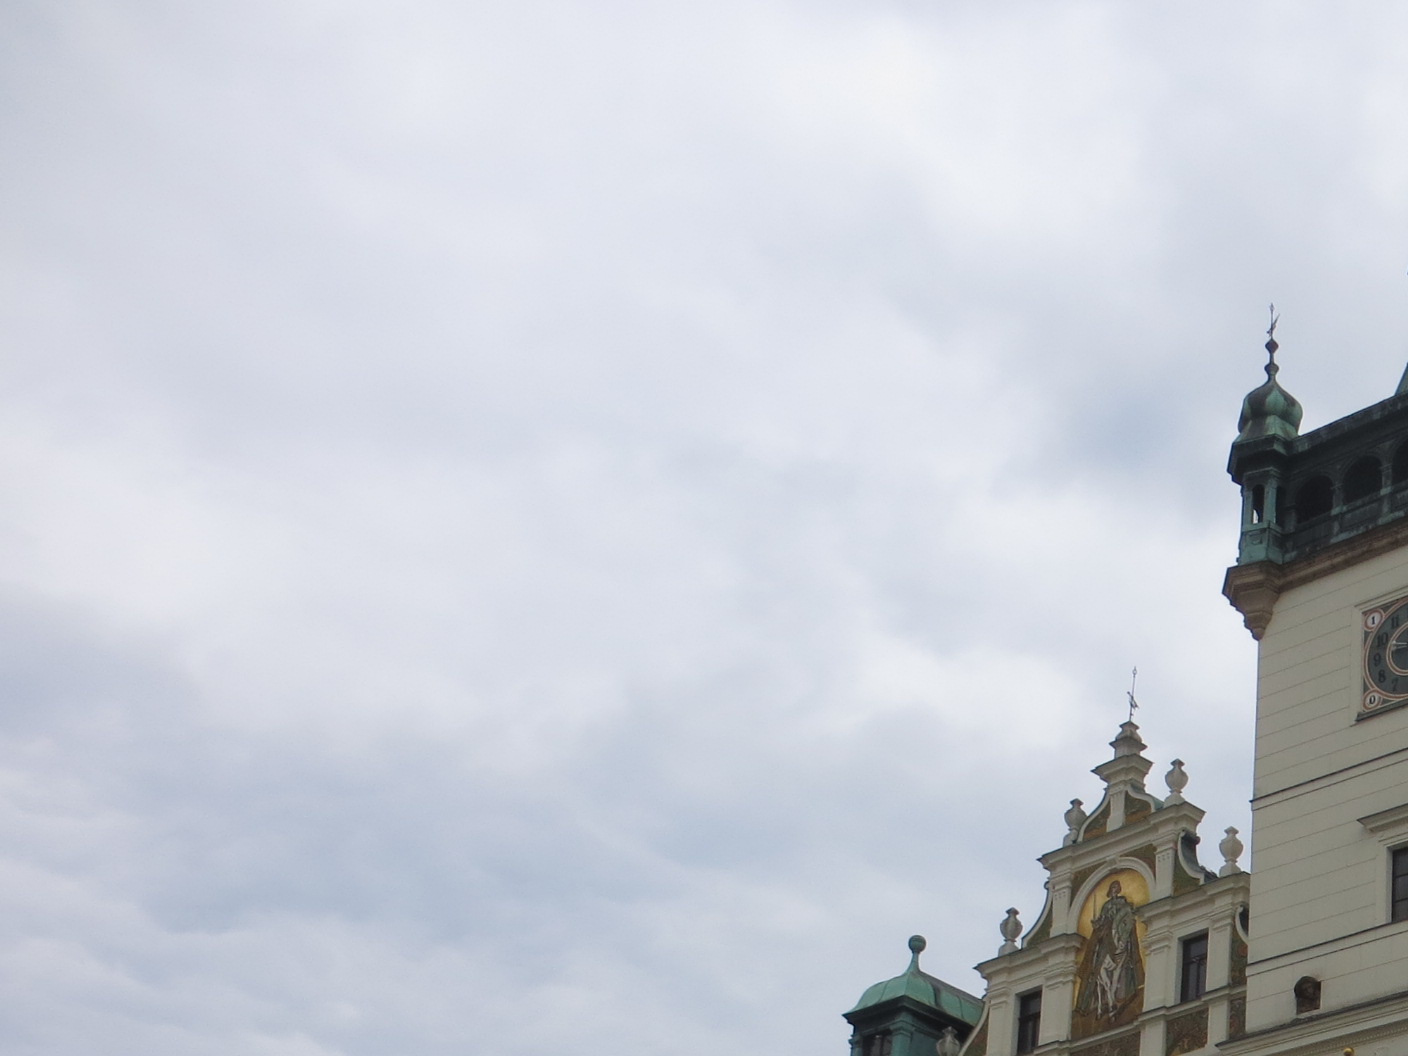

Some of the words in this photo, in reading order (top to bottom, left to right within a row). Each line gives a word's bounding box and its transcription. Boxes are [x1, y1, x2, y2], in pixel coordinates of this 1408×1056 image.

[1391, 614, 1400, 630] 11
[1377, 632, 1388, 647] 10
[1374, 653, 1381, 667] 9
[1378, 669, 1386, 683] 8
[1392, 678, 1398, 692] 7
[1369, 695, 1376, 705] 0
